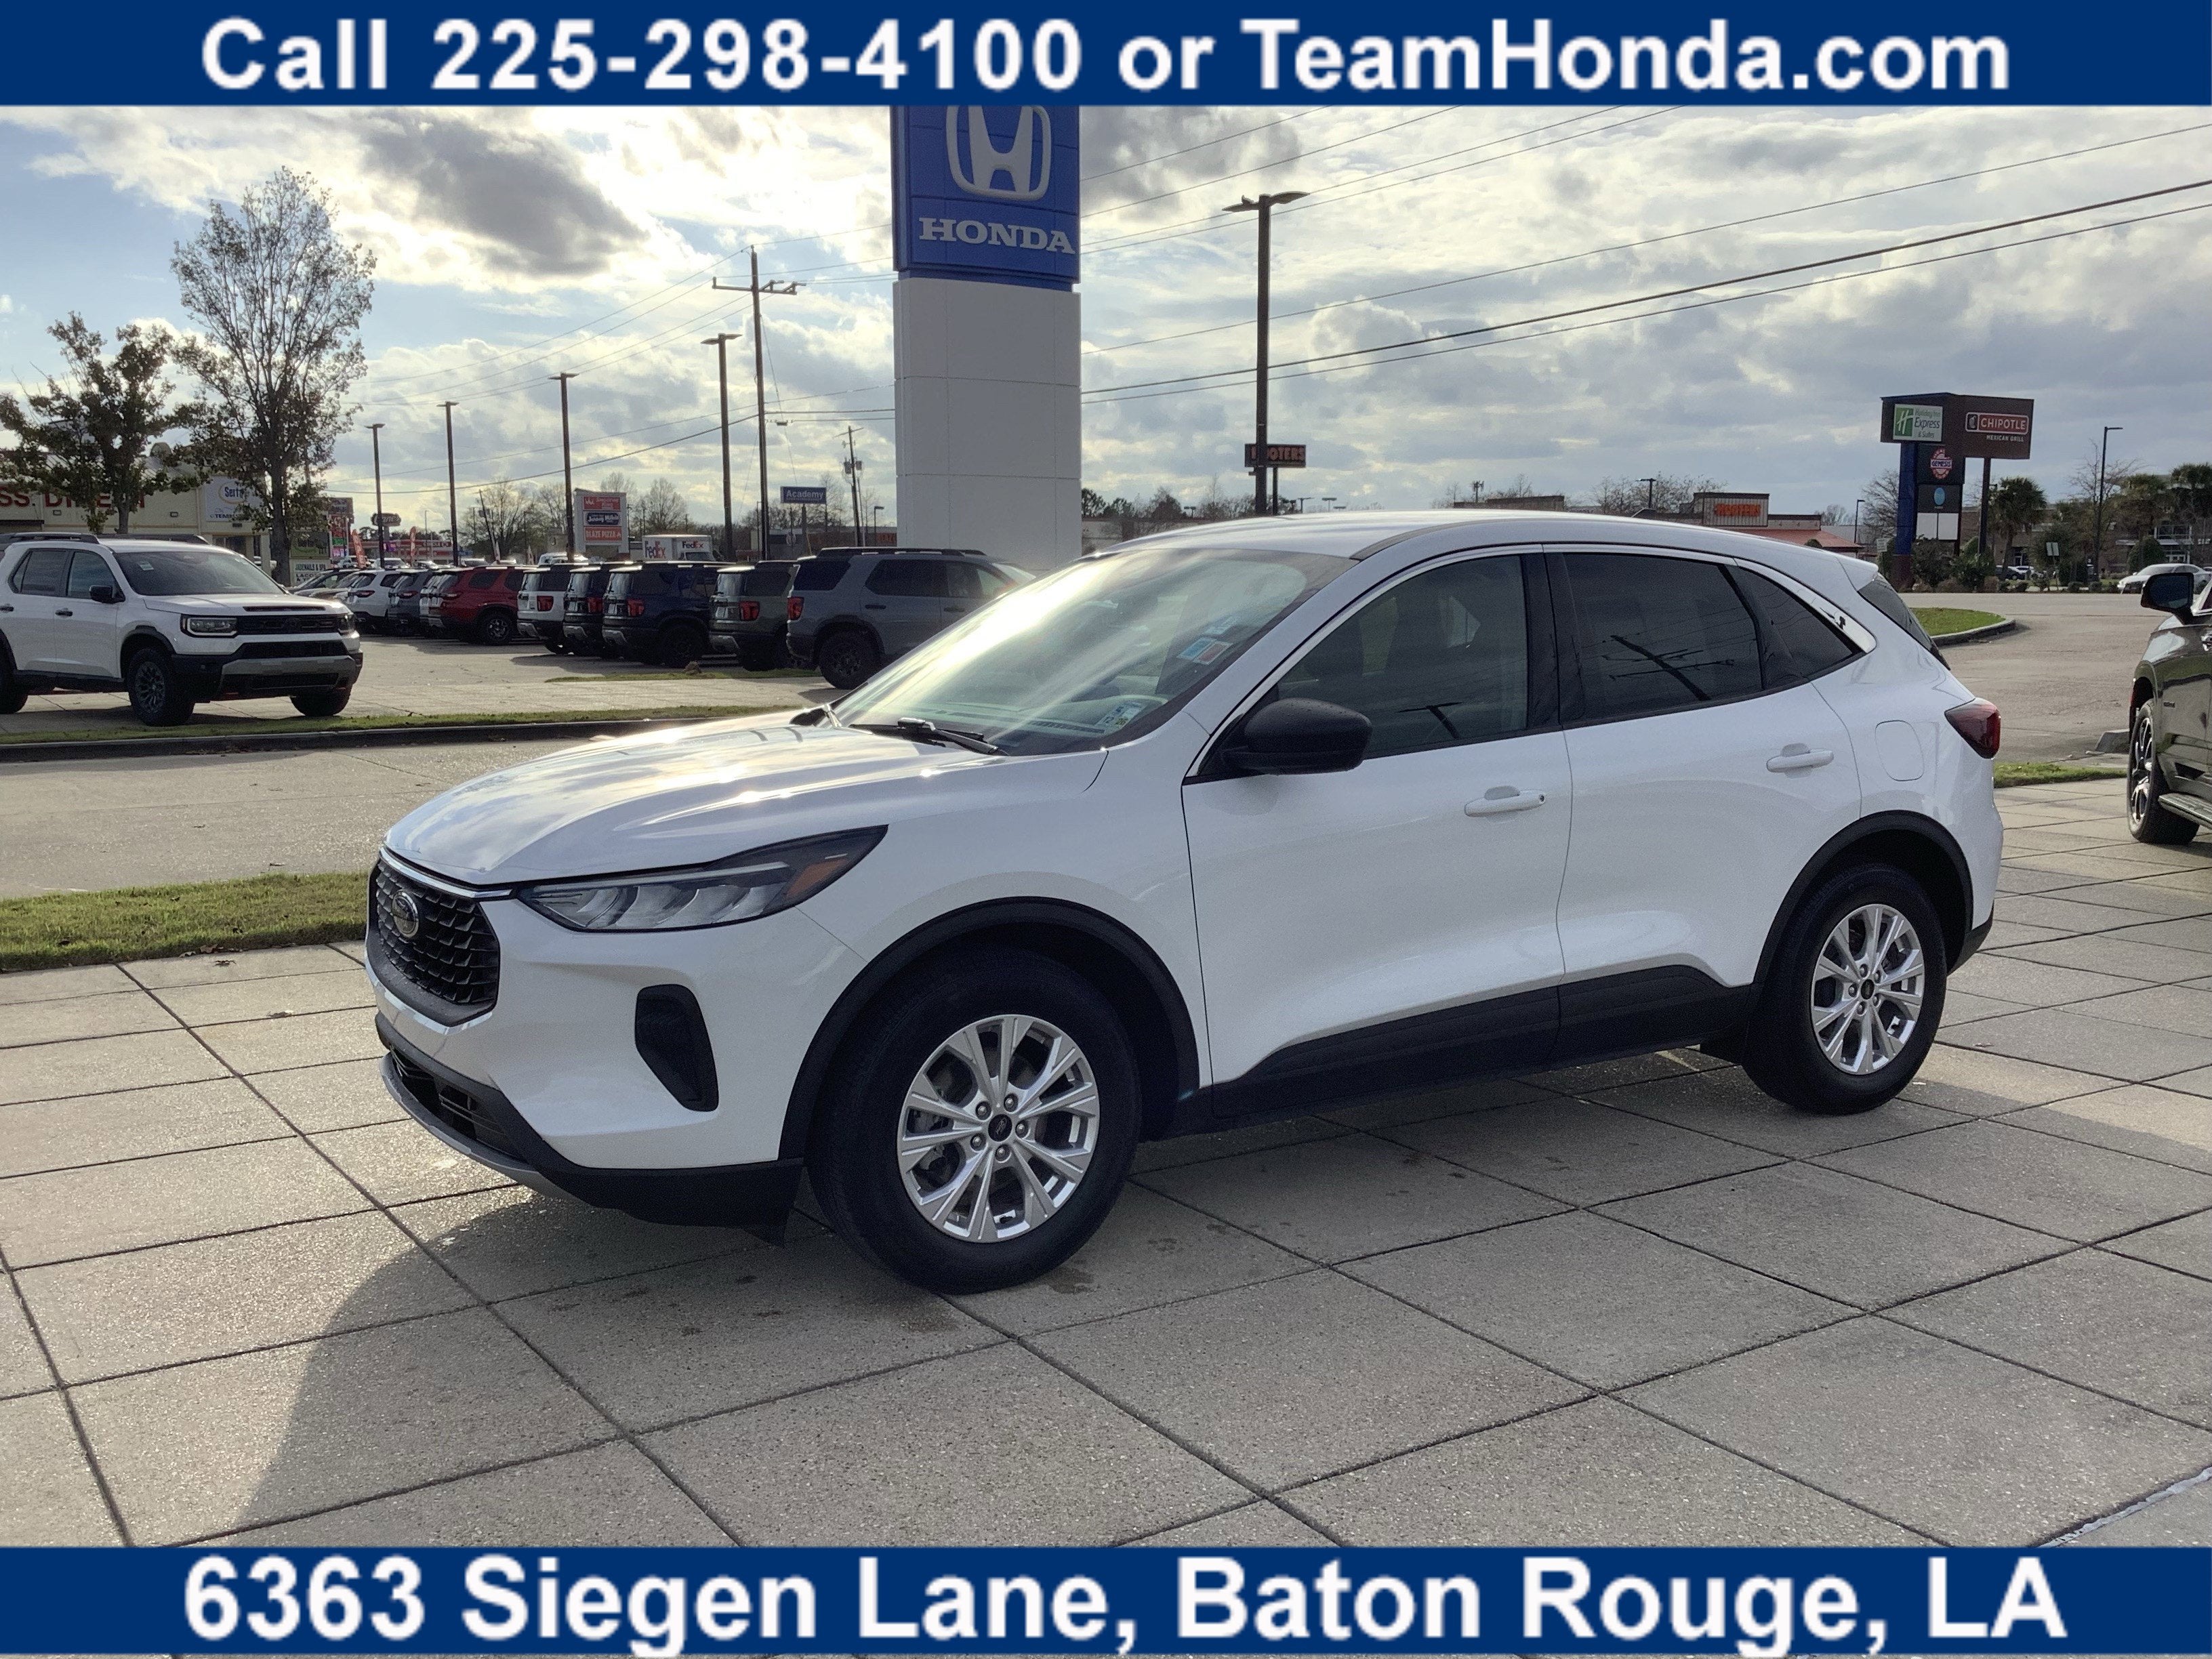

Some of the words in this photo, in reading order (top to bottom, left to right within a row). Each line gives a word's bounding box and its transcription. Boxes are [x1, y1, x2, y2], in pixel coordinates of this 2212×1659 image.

[918, 217, 1076, 255] HONDA
[1914, 417, 1940, 430] Express
[1980, 417, 2026, 430] CHIPOTLE
[1251, 447, 1305, 461] OTERS
[786, 489, 823, 499] Academy
[586, 530, 601, 538] BLAZE
[602, 530, 616, 538] PIZZA
[644, 540, 667, 558] FedEx
